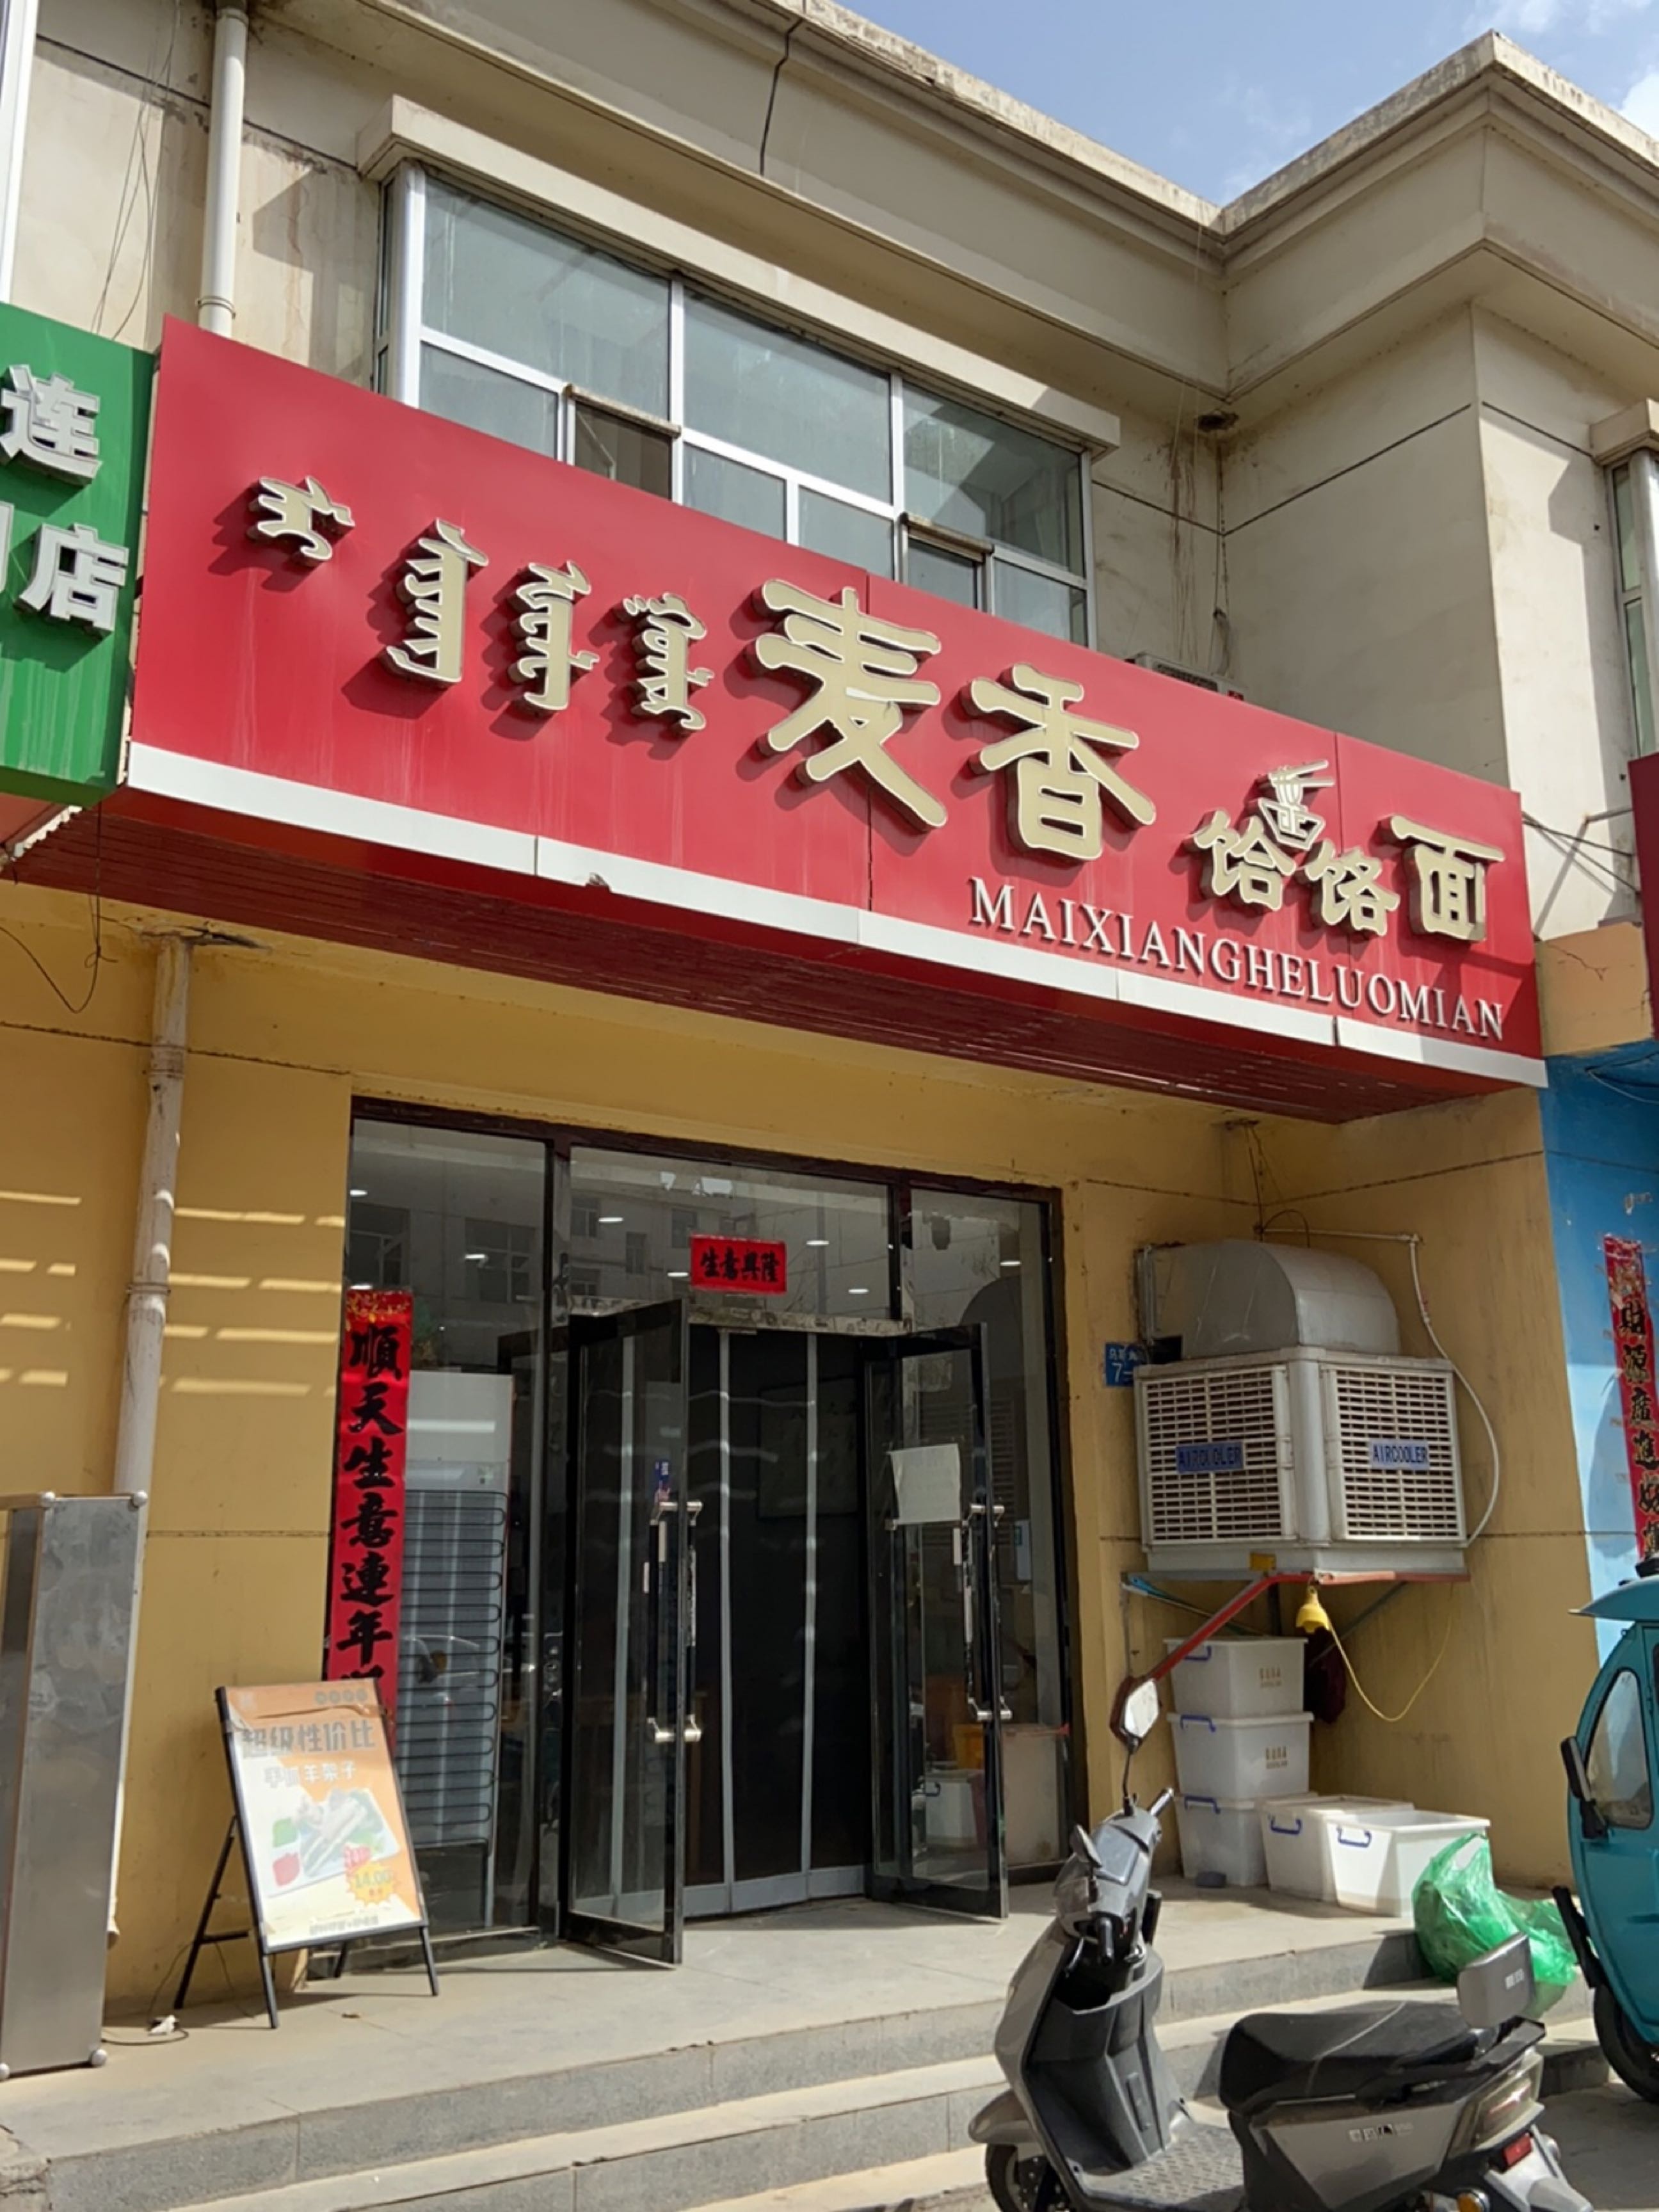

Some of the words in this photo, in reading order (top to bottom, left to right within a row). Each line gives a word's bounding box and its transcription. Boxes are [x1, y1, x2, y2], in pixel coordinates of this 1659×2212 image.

[0, 501, 129, 634] 店
[754, 579, 1506, 942] 麦香饸饹面
[969, 876, 1503, 1041] MAIXIANGHELUOMIAN
[336, 1324, 406, 1680] 順天生意連年
[1373, 1445, 1428, 1463] AIRCOOLER
